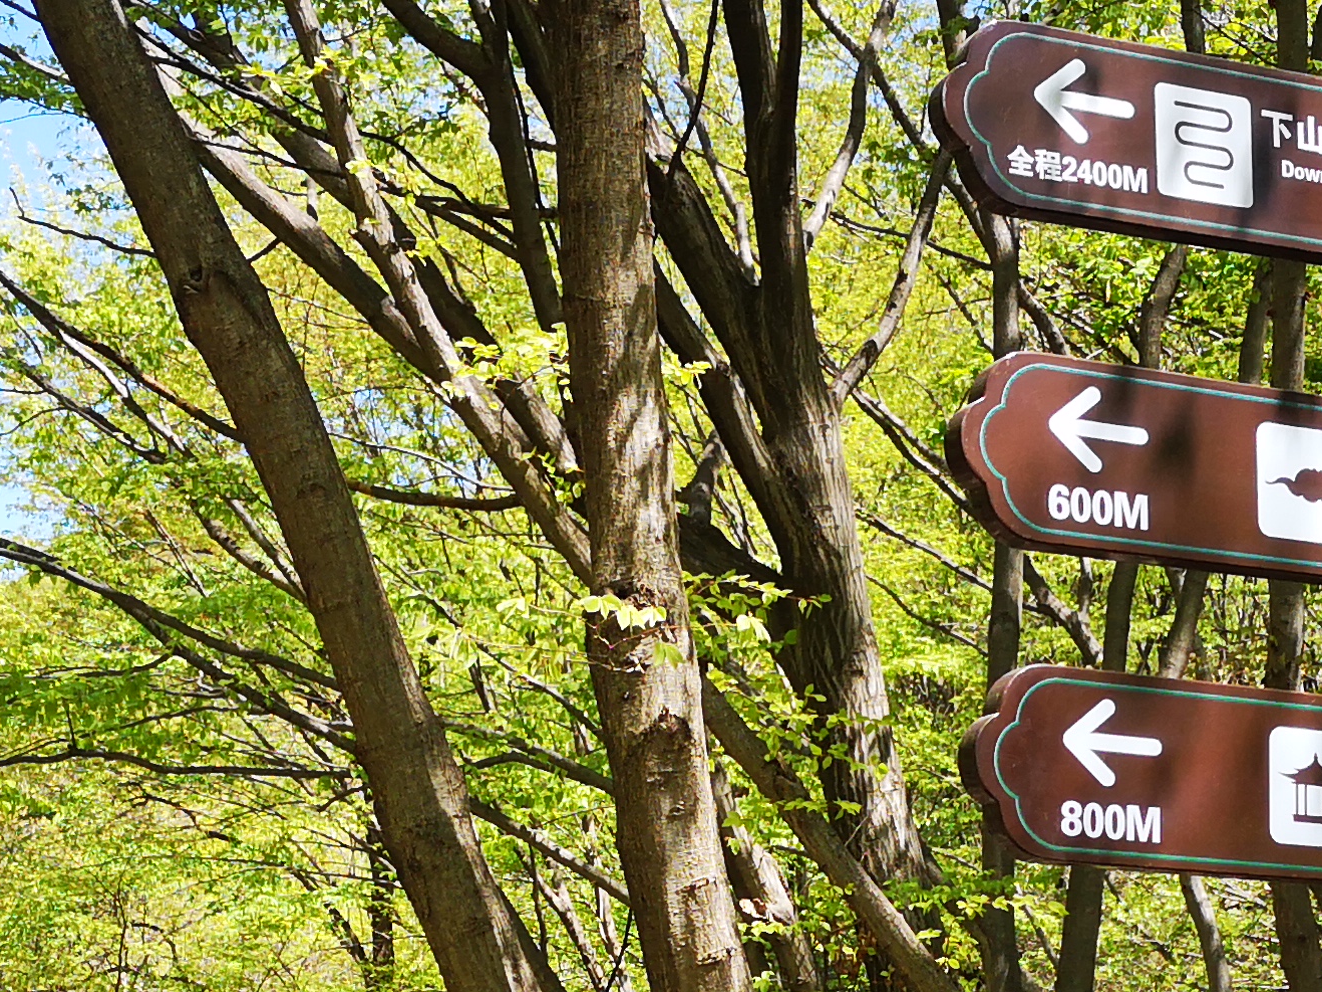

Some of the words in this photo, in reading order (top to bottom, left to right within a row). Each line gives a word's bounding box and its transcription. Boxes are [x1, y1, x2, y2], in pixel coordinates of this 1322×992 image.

[1007, 145, 1148, 194] 全程2400M
[1048, 484, 1149, 531] 600M
[1061, 800, 1162, 844] 800M
